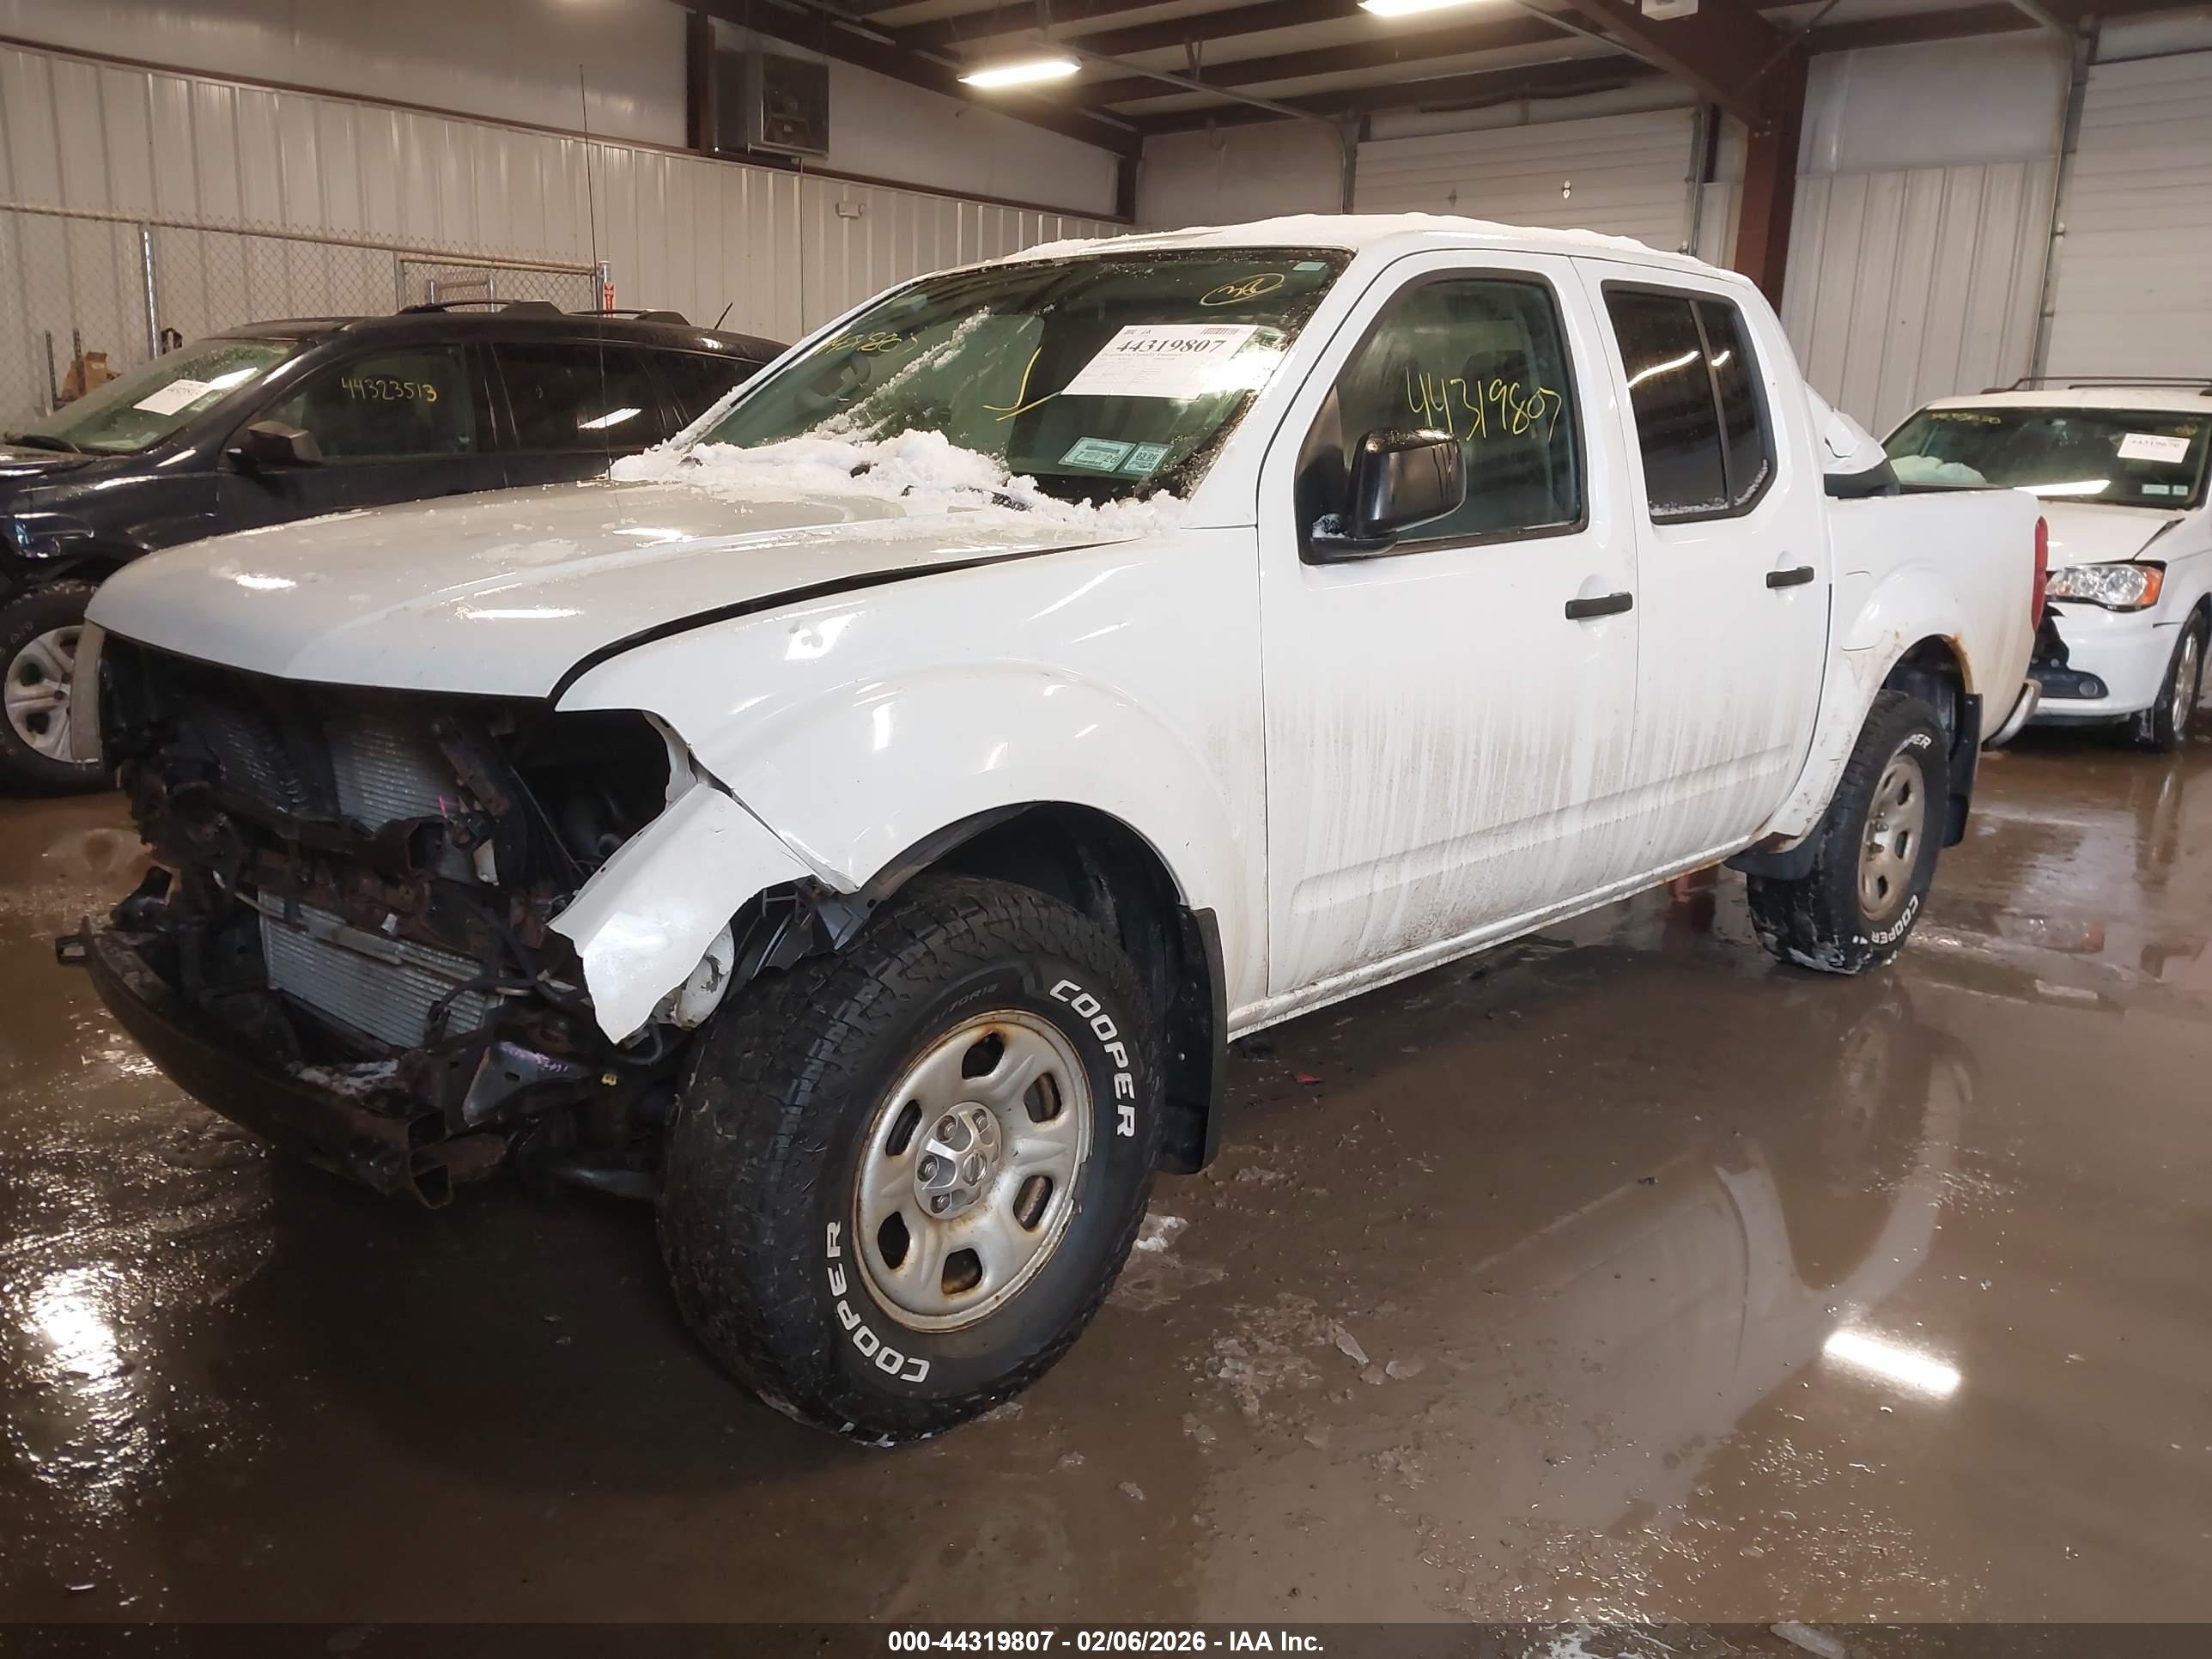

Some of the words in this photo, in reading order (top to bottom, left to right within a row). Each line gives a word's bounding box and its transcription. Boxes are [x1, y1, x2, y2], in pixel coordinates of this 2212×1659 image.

[1116, 338, 1227, 353] 44319807
[341, 376, 438, 402] 44323513
[1404, 366, 1563, 442] 44319807
[1870, 894, 1919, 945] COOPER
[1048, 978, 1136, 1138] COOPER
[825, 1219, 931, 1383] COOPER
